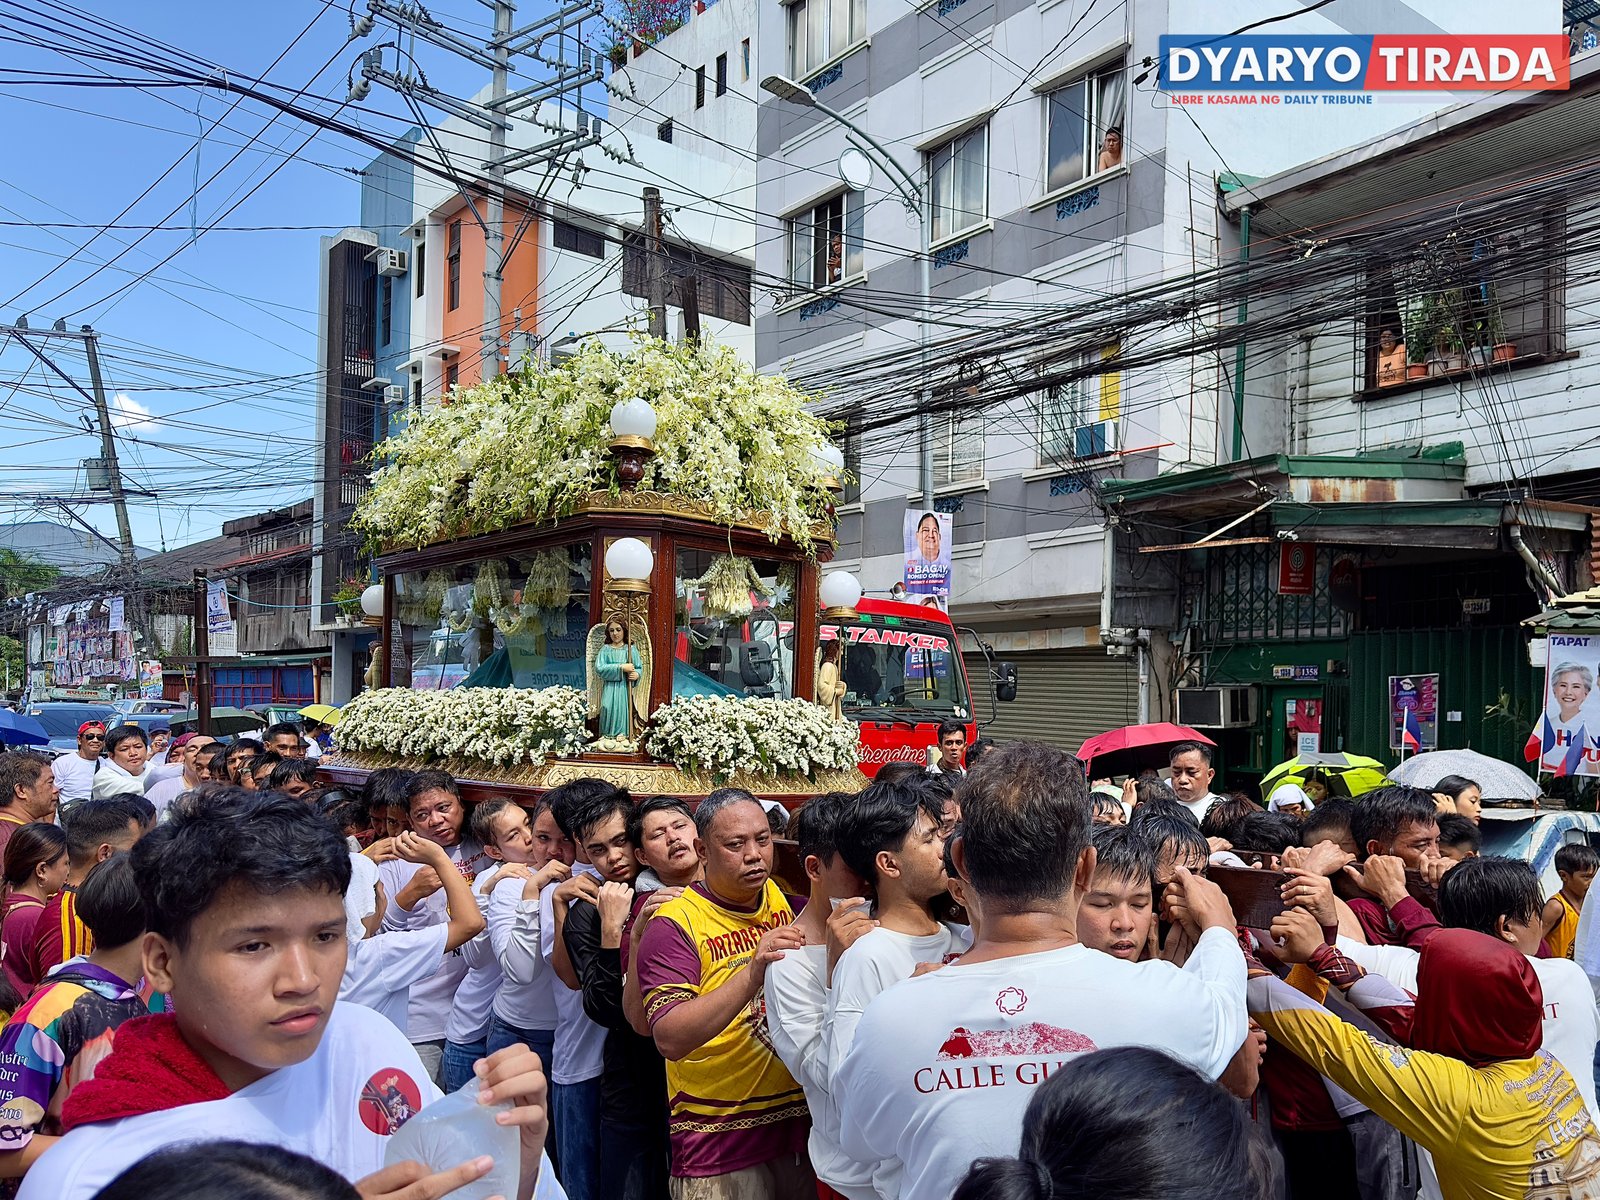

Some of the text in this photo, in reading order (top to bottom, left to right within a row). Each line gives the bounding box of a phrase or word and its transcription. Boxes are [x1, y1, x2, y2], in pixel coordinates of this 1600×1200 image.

[915, 564, 948, 574] BAGAY,
[846, 626, 951, 653] TANKER
[1551, 636, 1591, 647] TAPAT
[1301, 668, 1318, 676] 1358
[1301, 737, 1315, 745] ICE
[913, 1061, 1064, 1094] CALLE GU
